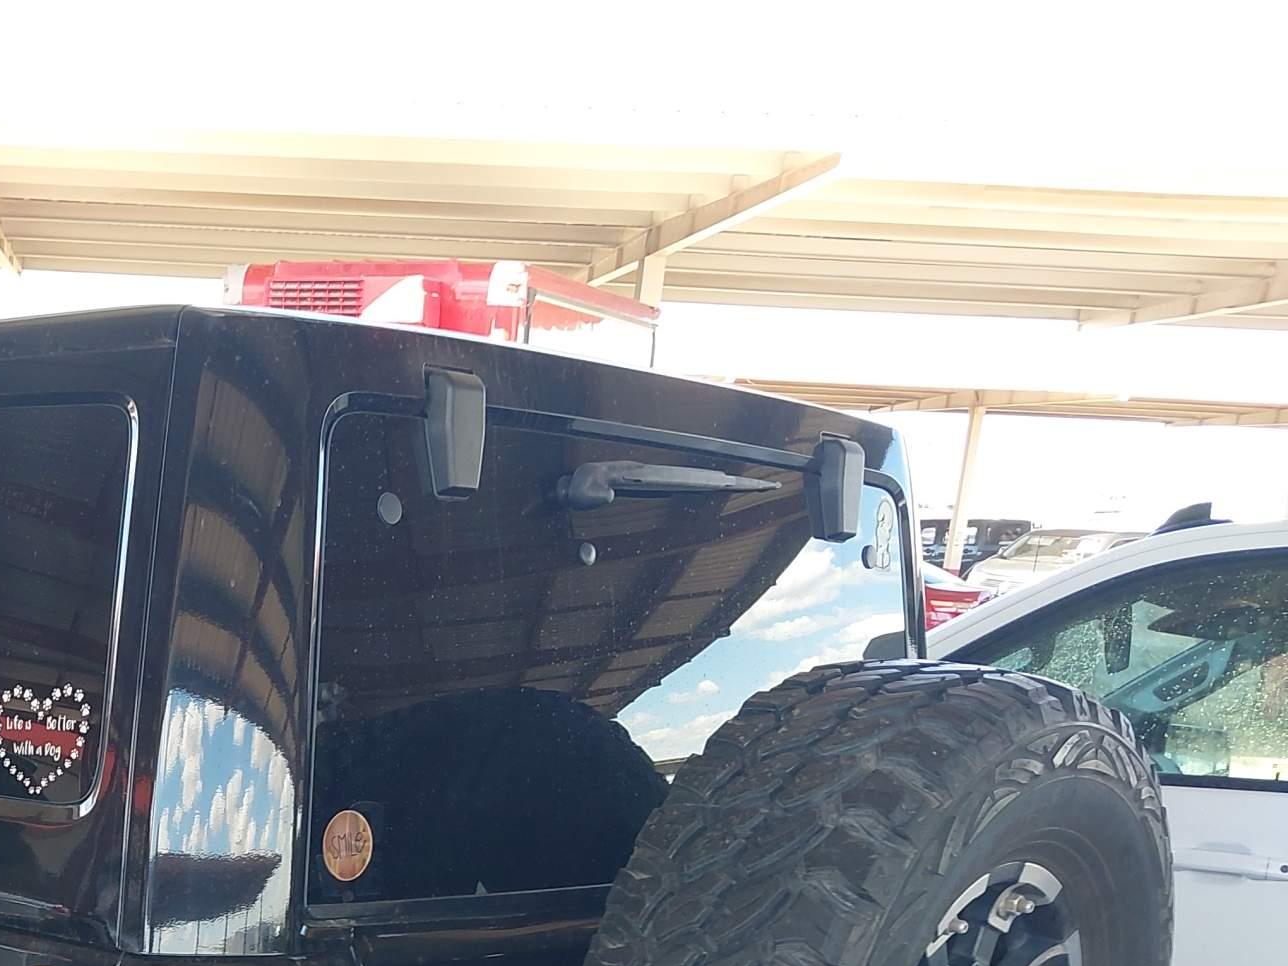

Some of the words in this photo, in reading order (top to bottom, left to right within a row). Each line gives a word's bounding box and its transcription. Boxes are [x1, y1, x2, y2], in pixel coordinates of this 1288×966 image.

[6, 715, 24, 730] Life
[25, 718, 32, 730] is
[46, 714, 77, 731] Better
[35, 745, 43, 756] a
[44, 742, 62, 761] Dog
